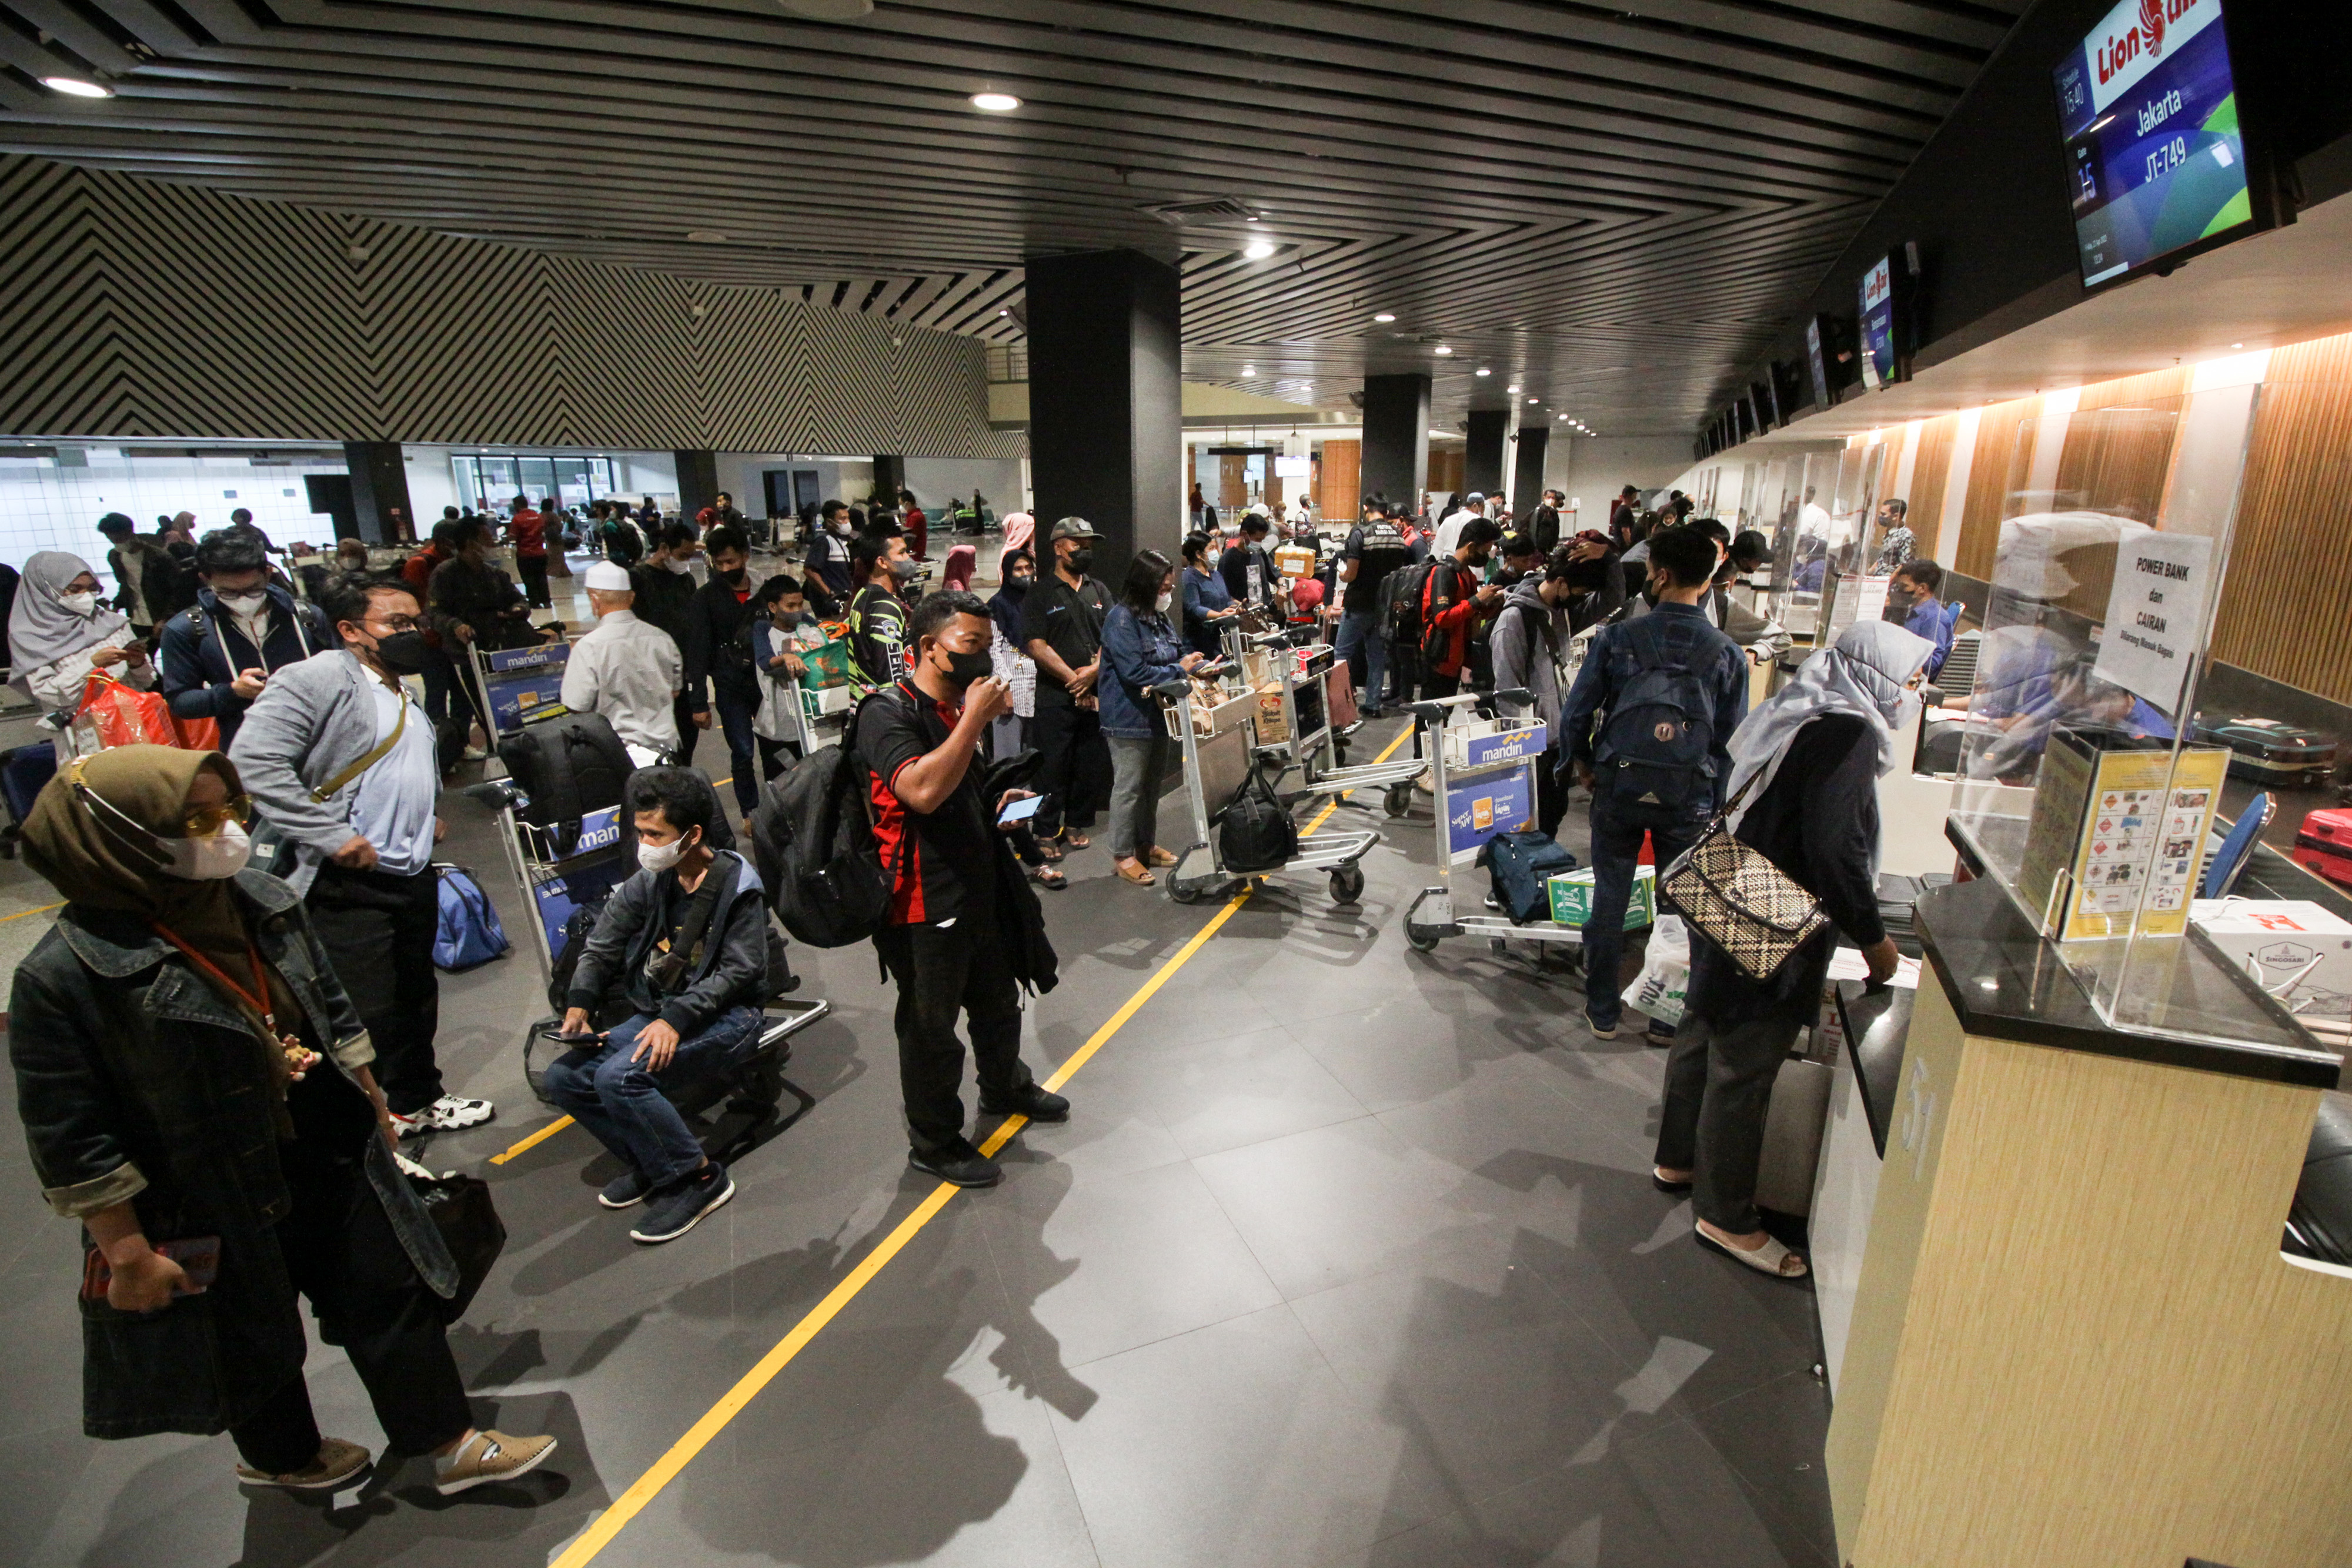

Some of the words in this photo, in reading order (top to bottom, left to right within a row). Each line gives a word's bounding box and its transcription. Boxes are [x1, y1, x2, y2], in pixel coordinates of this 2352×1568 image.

[2098, 26, 2140, 85] Lion
[2137, 90, 2182, 137] Jakarta
[2146, 136, 2186, 183] JT-749
[2136, 557, 2164, 576] POWER
[2165, 563, 2190, 581] BANK
[2149, 588, 2163, 604] dan
[2137, 611, 2167, 633] CAIRAN
[507, 653, 547, 666] mandiri
[1482, 742, 1522, 762] mandiri
